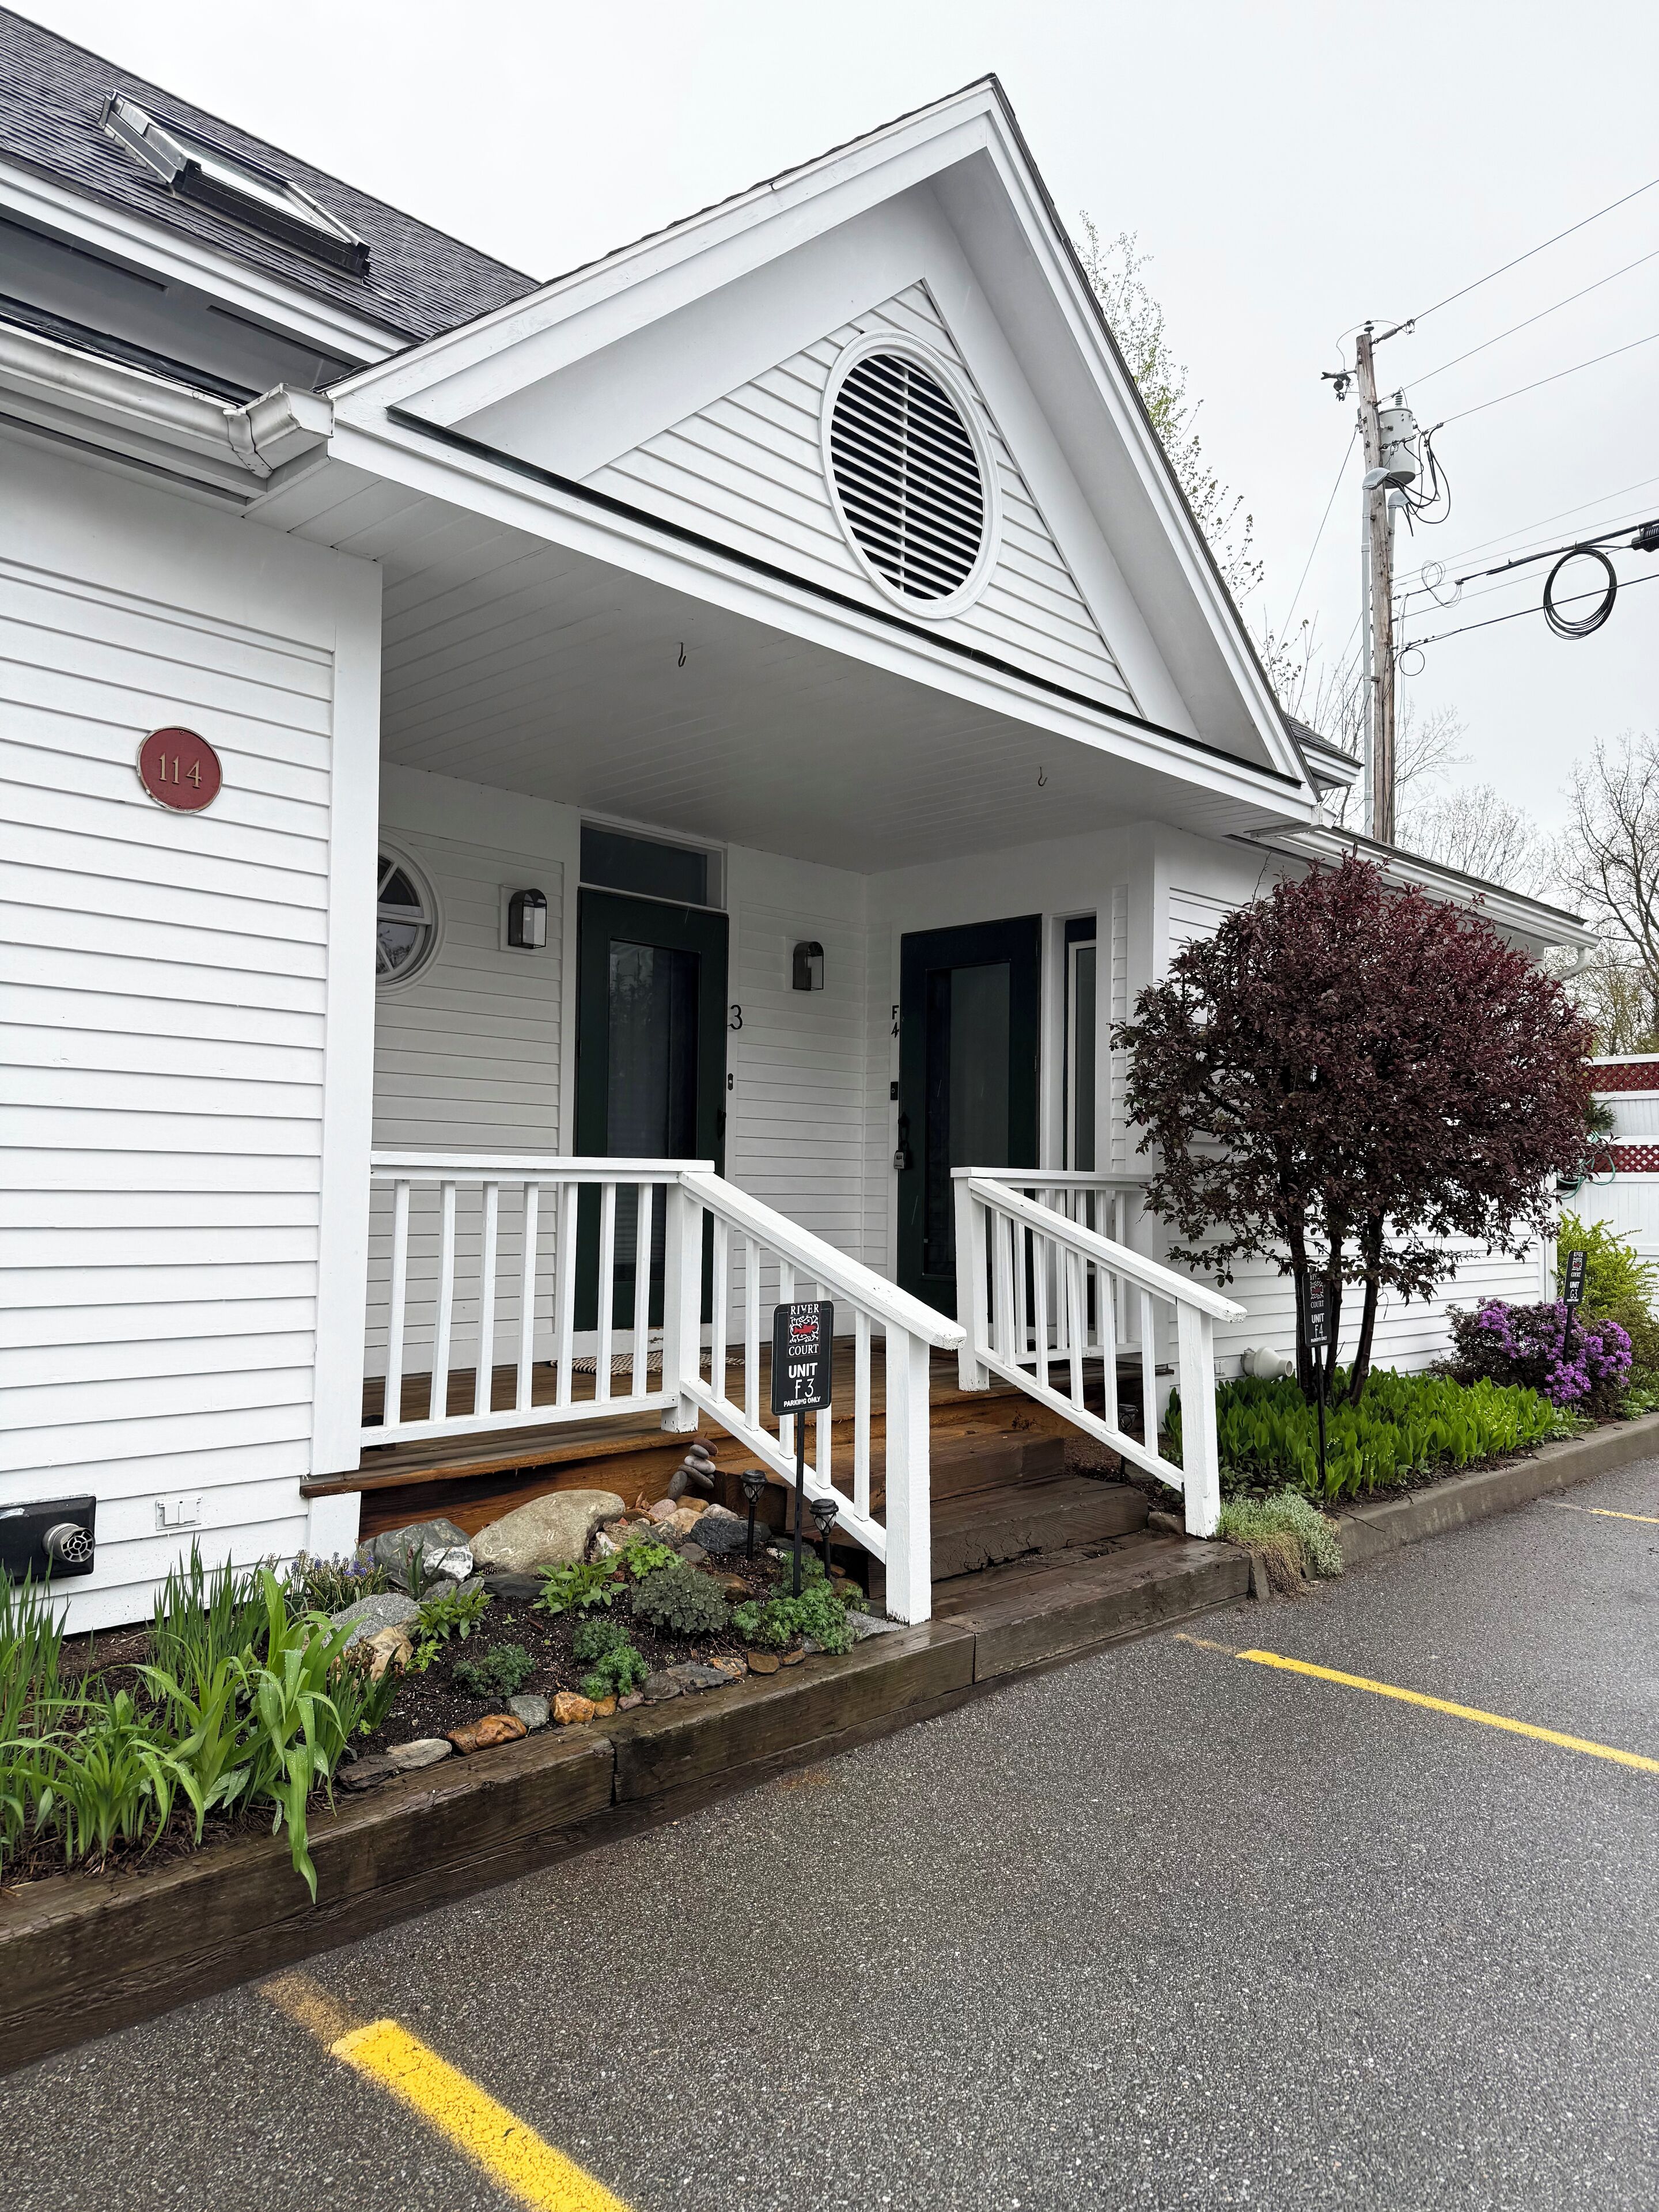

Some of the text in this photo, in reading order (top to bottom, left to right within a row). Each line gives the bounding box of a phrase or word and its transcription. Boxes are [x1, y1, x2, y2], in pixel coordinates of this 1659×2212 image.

[158, 752, 202, 789] 114
[730, 1005, 743, 1030] 3
[1570, 1289, 1578, 1299] G3
[790, 1304, 820, 1315] RIVER
[1310, 1300, 1324, 1308] COURT
[1312, 1313, 1325, 1324] UNIT
[788, 1344, 819, 1356] COURT
[788, 1362, 818, 1378] UNIT
[783, 1396, 821, 1407] PARKING ONLY
